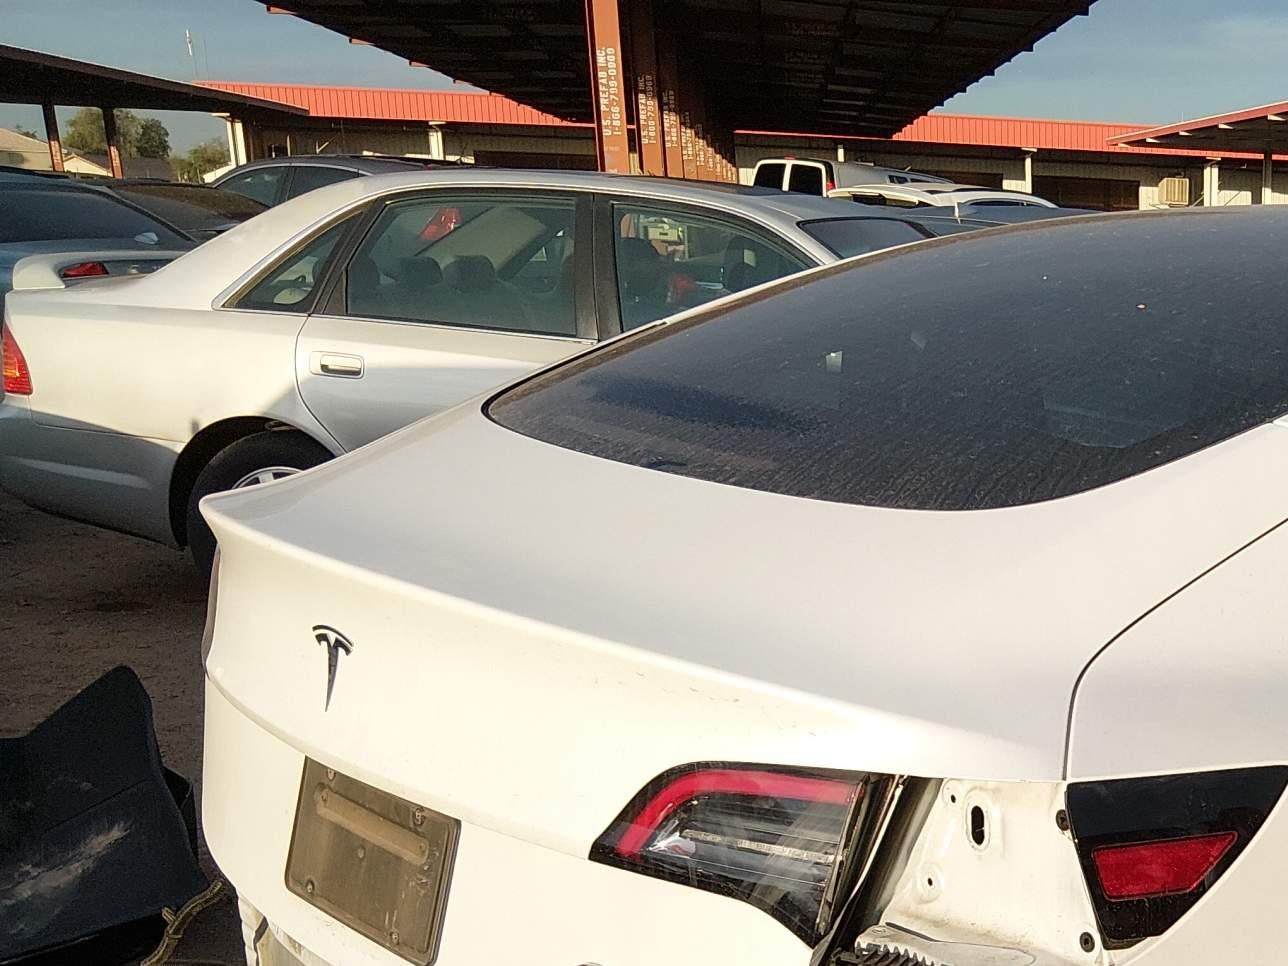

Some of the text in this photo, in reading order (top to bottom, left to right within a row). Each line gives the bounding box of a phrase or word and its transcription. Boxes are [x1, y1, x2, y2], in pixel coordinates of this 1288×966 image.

[596, 47, 612, 136] U.S. PREFAB INC.
